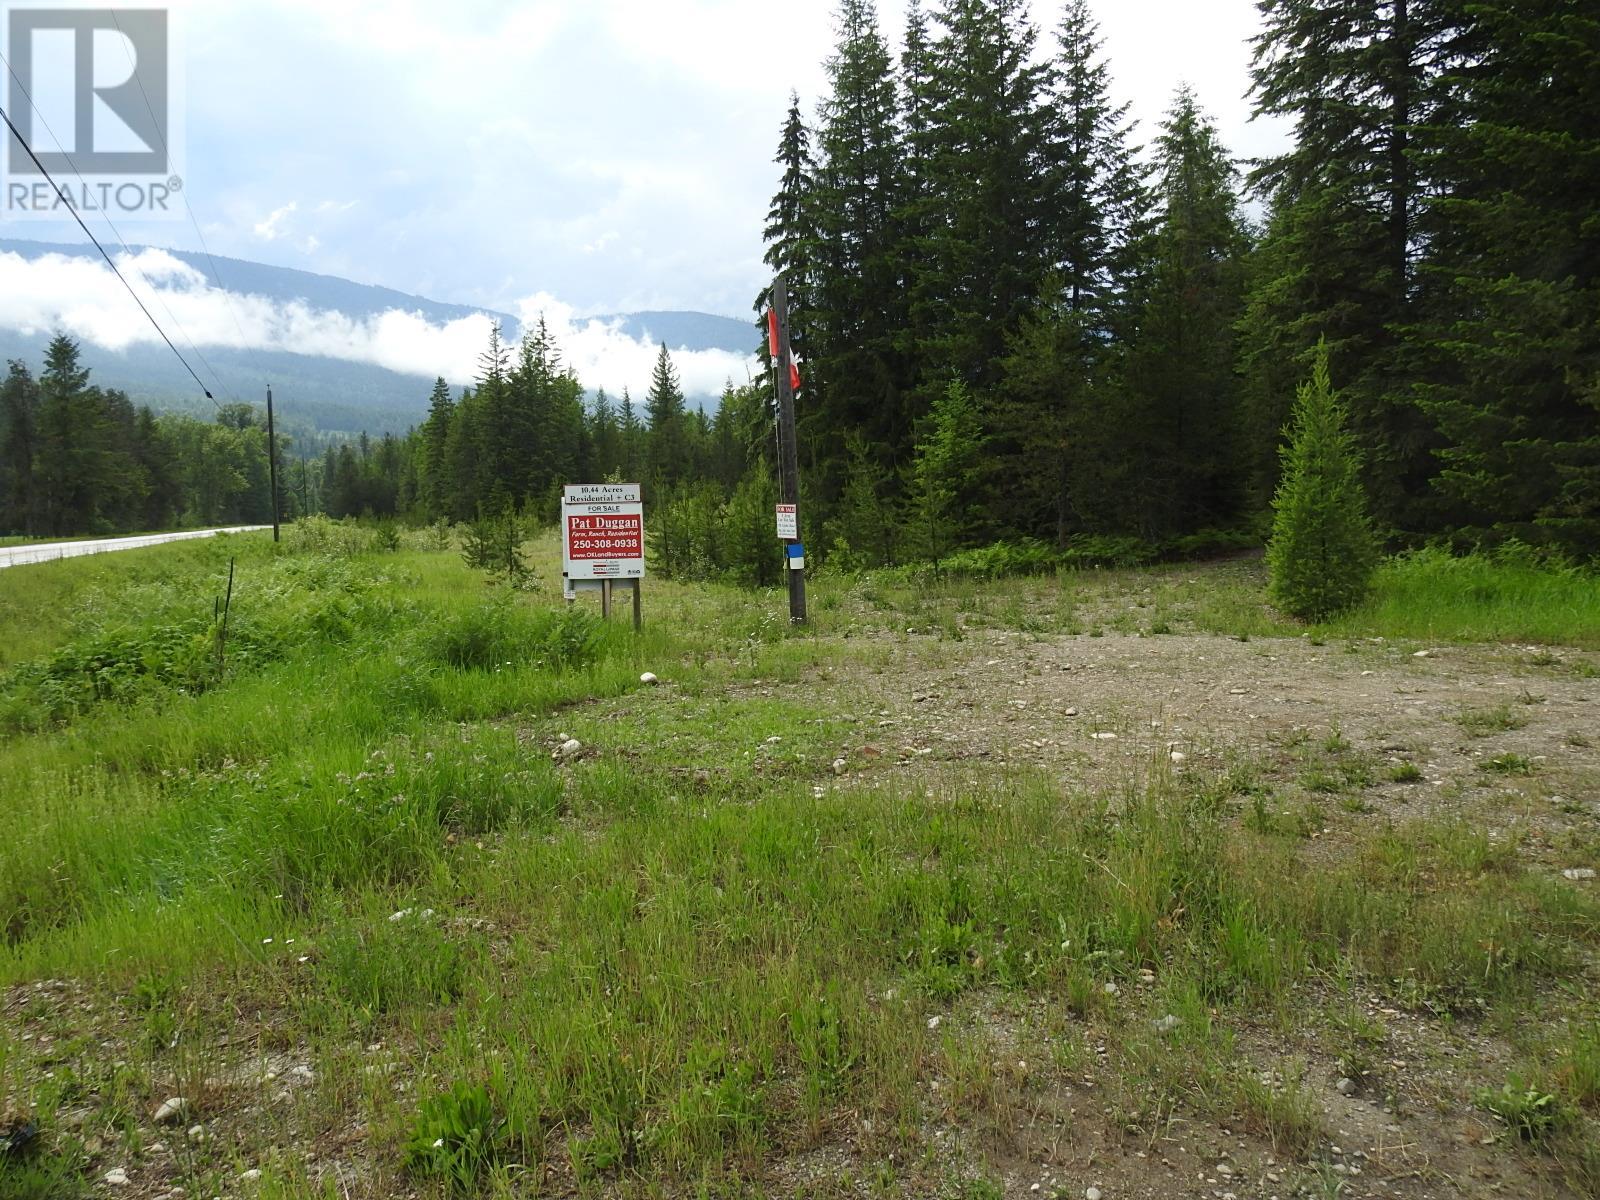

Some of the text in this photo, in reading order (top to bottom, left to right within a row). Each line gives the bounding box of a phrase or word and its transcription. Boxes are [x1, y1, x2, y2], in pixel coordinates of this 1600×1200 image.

[581, 486, 599, 494] 10.44
[571, 517, 638, 529] Pat Duggan
[573, 539, 638, 549] 250-308-0938
